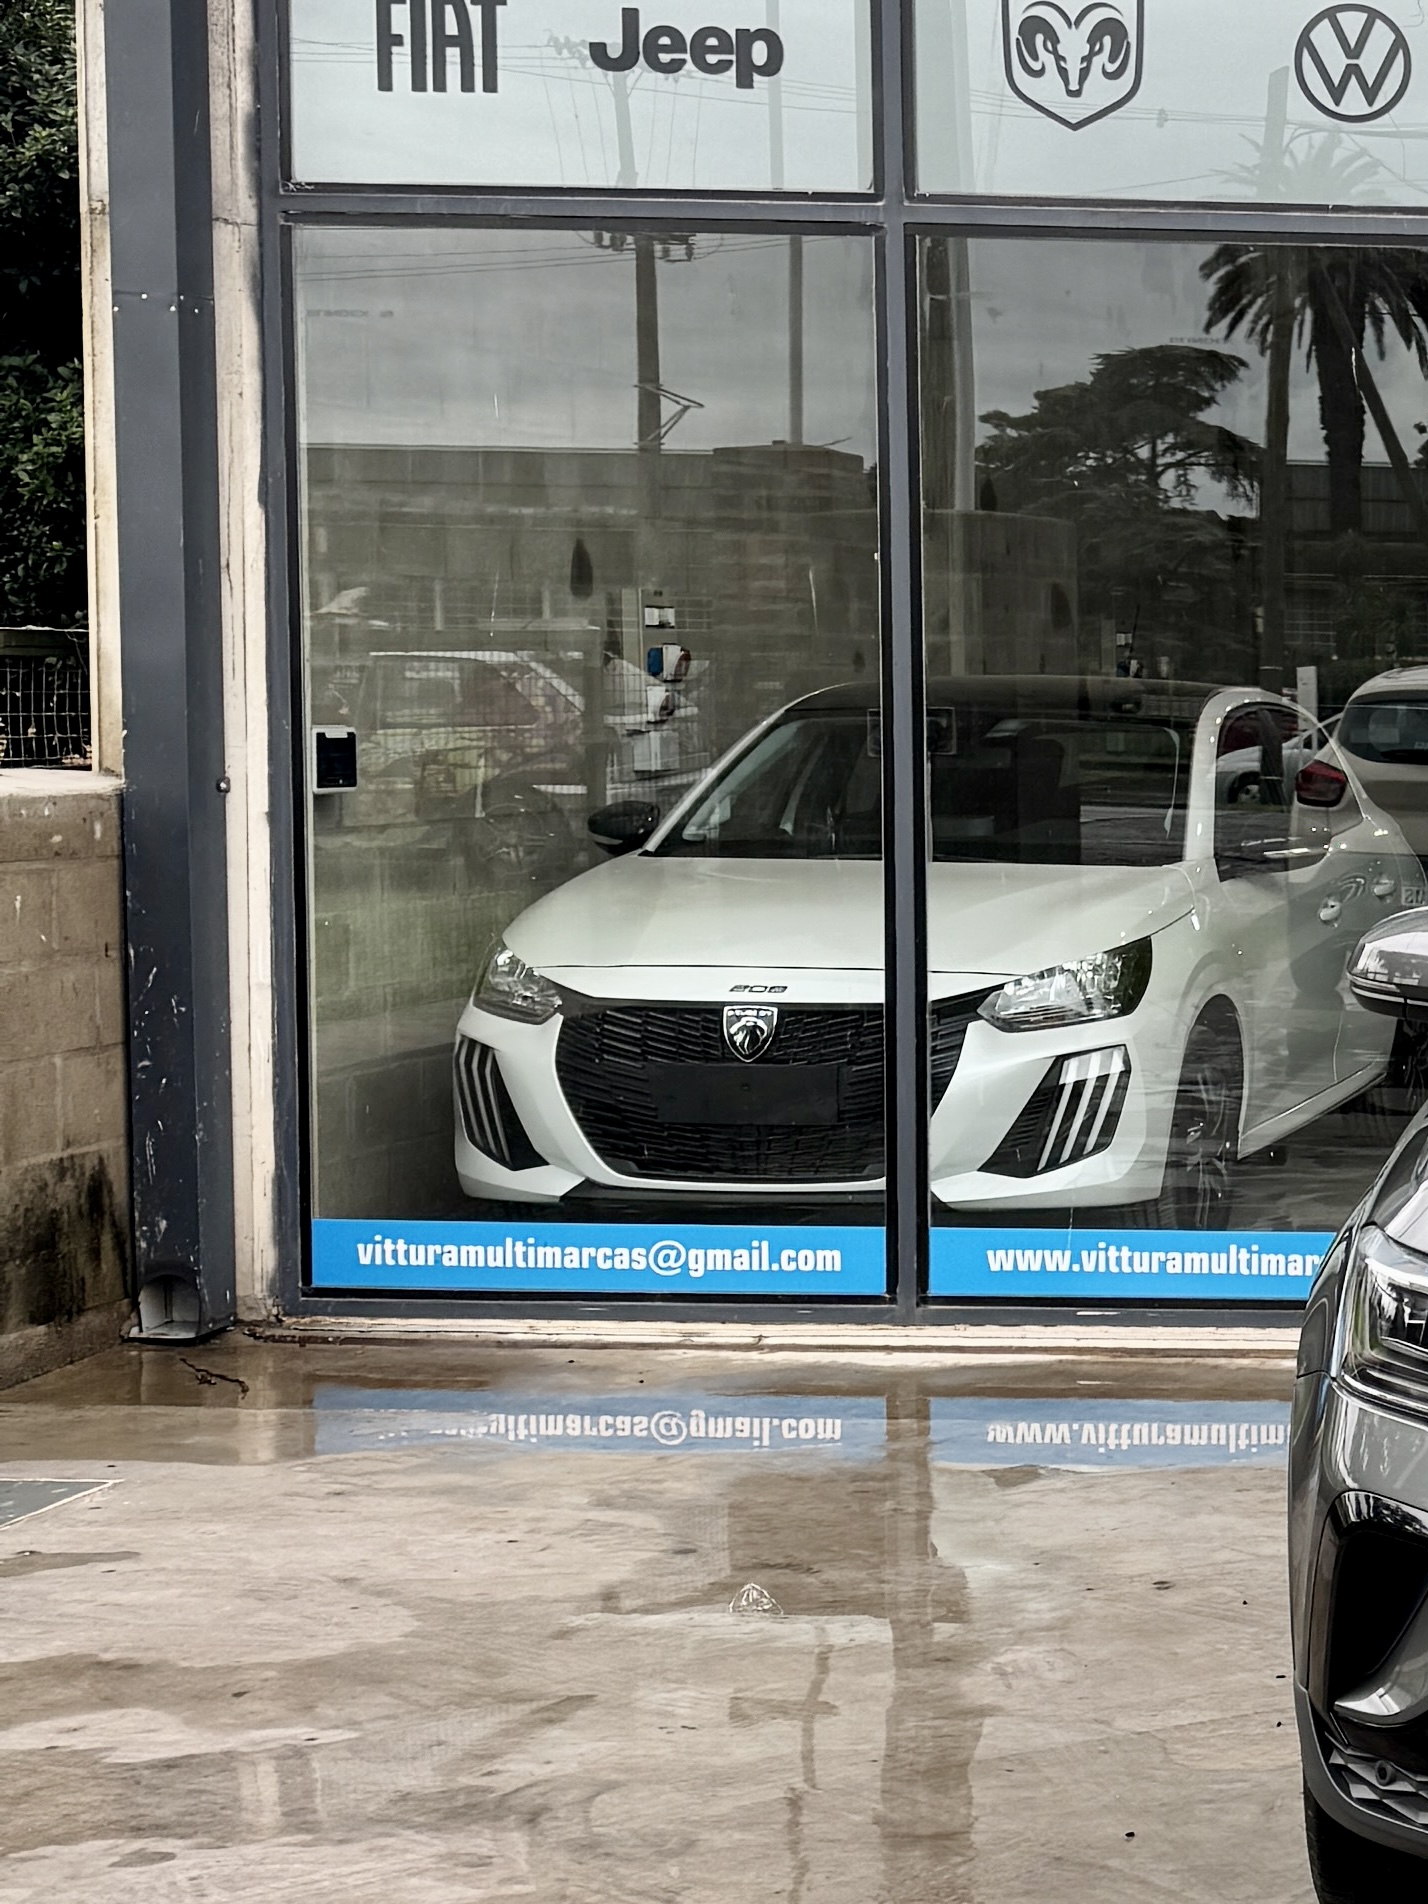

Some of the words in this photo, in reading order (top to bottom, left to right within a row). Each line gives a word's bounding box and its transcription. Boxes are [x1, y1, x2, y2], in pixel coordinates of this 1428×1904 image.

[588, 7, 785, 89] Jeep
[357, 1235, 842, 1278] vitturamultimarcas@gmail.com
[987, 1238, 1326, 1278] www.vitturamultimar
